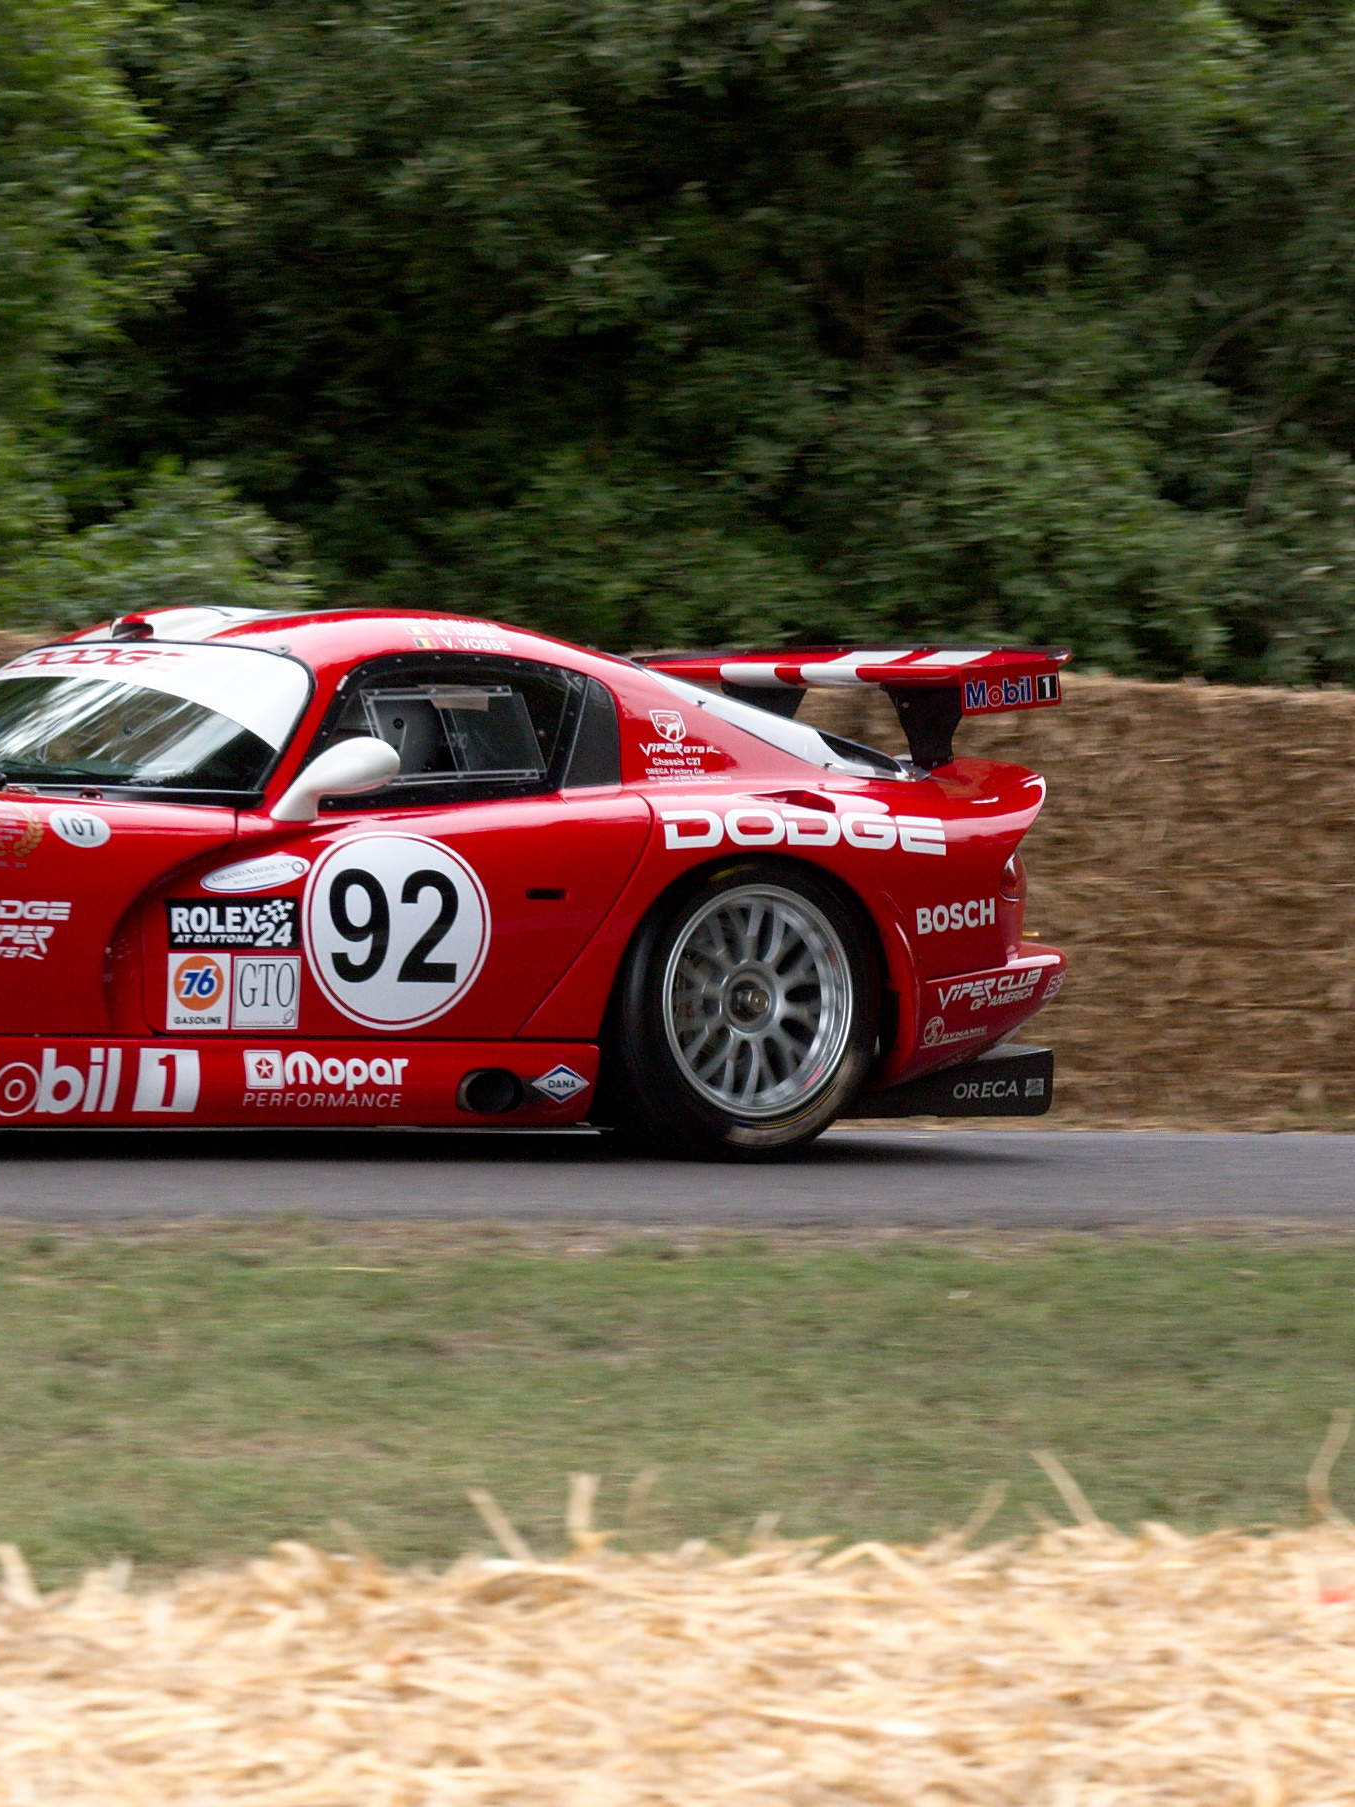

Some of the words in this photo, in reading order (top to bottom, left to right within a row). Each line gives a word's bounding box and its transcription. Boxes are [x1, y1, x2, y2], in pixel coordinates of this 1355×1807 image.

[440, 637, 458, 650] V.
[965, 675, 1033, 709] Mobil
[638, 742, 684, 756] VIPER
[652, 757, 685, 766] Chassis
[59, 817, 96, 838] 107
[660, 808, 947, 856] DODGE
[170, 906, 260, 933] ROLEX
[254, 921, 293, 947] 24
[329, 868, 459, 983] 92
[916, 897, 996, 935] BOSCH
[173, 934, 193, 943] AT
[193, 934, 254, 944] DAYTONA
[180, 965, 216, 998] 76
[239, 962, 295, 1008] GTO
[938, 977, 997, 1011] VIPER
[997, 968, 1043, 992] CLUB
[969, 997, 987, 1012] OF
[987, 986, 1034, 1008] AMERICA
[173, 1016, 222, 1025] GASOLINE
[284, 1051, 409, 1091] Mopar
[548, 1079, 576, 1089] DANA
[242, 1093, 402, 1108] PERFORMANCE
[952, 1081, 1019, 1099] ORECA
